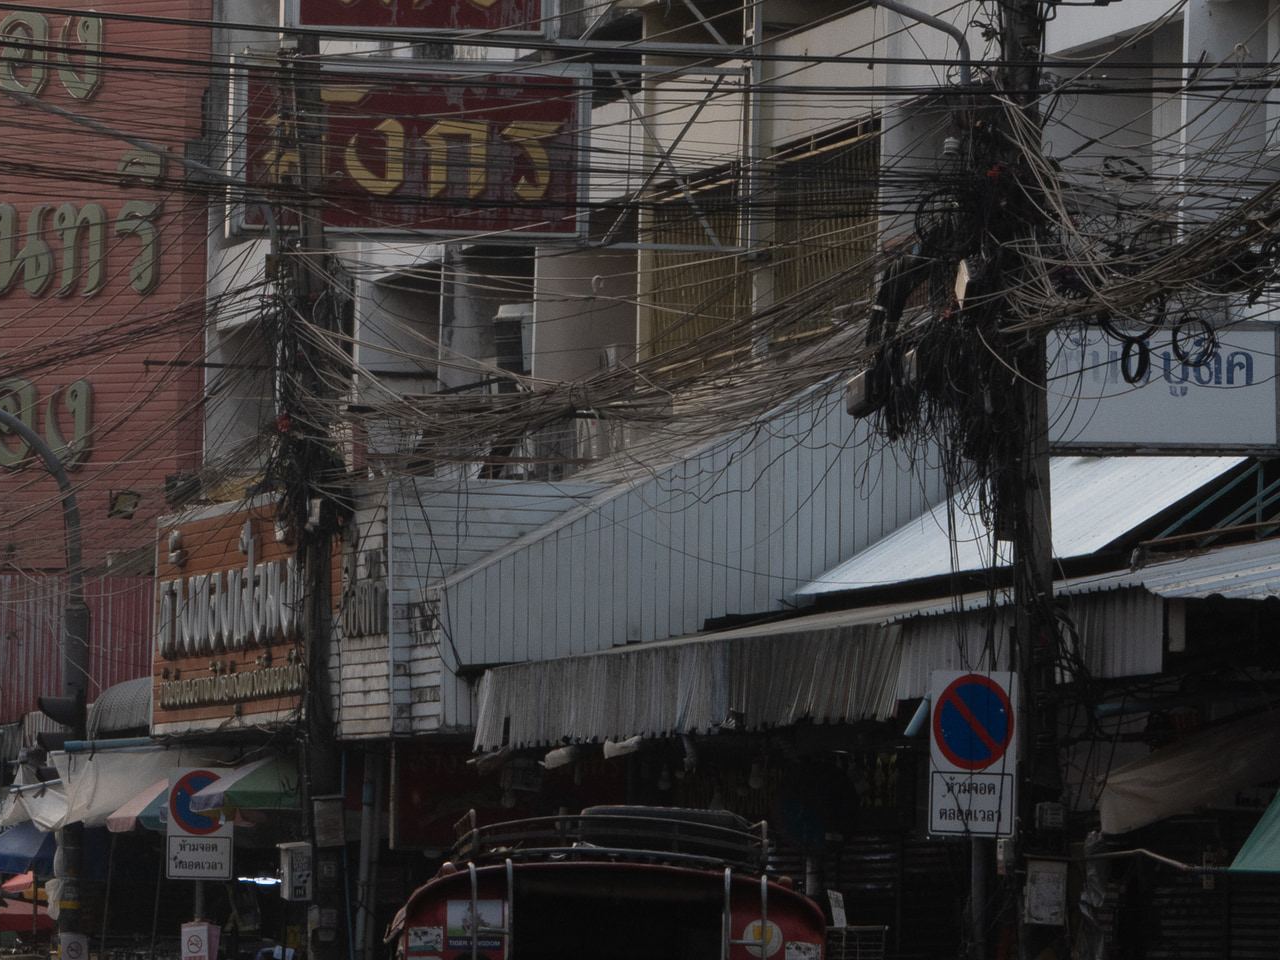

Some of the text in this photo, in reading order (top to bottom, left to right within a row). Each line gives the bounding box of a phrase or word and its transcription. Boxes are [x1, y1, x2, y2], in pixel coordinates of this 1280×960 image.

[946, 776, 996, 795] ห้ามจอด
[939, 807, 1002, 822] ตลอดเวลา
[179, 839, 218, 852] ห้ามจอด
